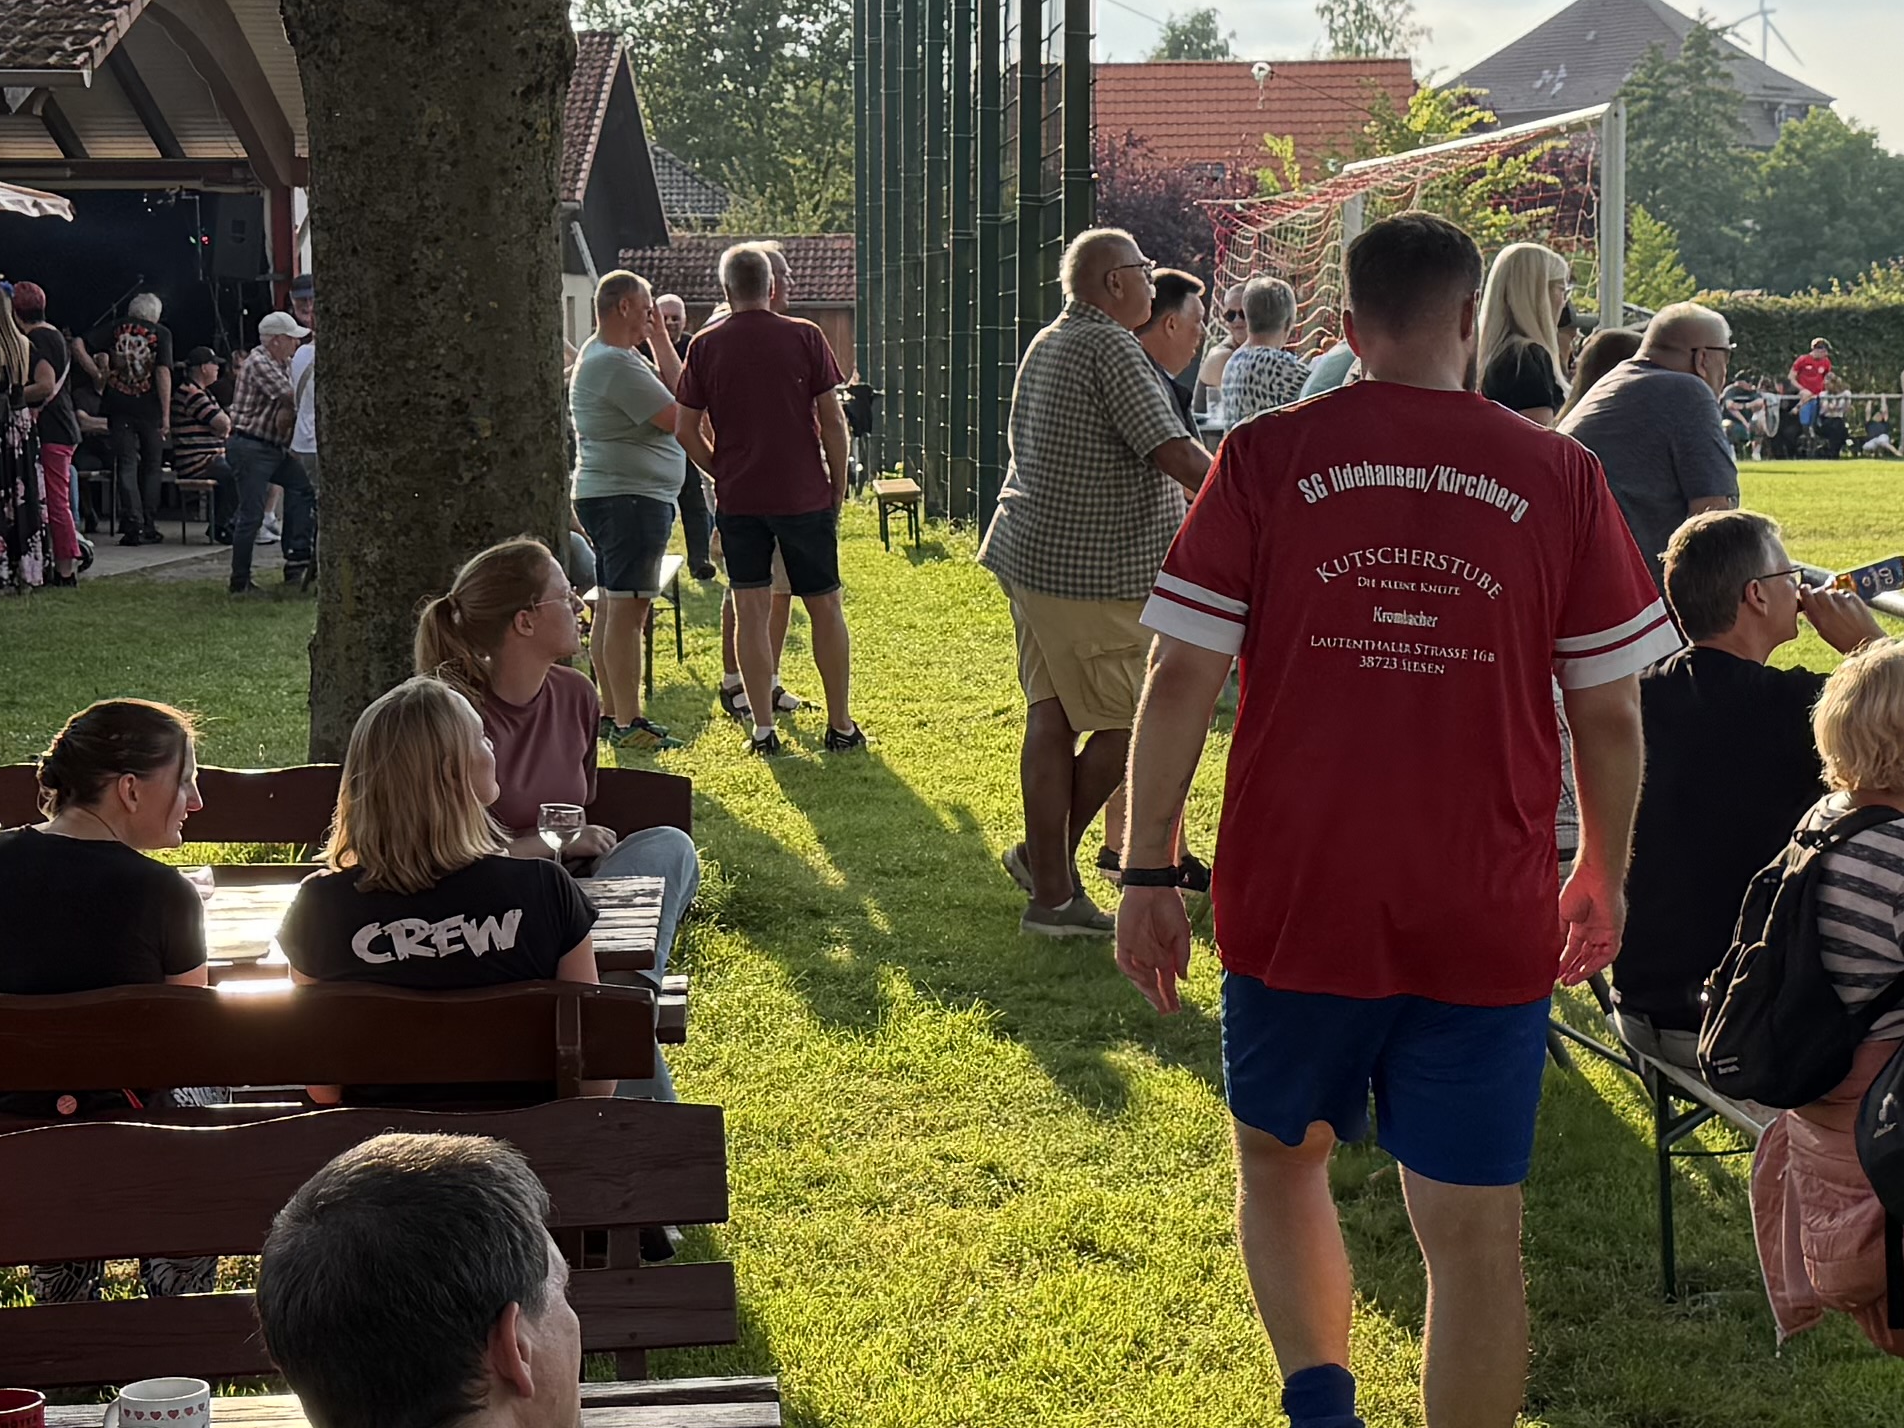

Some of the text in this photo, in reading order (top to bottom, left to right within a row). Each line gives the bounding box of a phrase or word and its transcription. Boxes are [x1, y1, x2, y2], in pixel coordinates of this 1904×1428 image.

[1297, 460, 1529, 523] SG Ildehausen/Kirchberg
[1315, 547, 1503, 600] KUTSCHERSTUBE
[1373, 606, 1438, 628] Krombacher
[1359, 655, 1398, 670] 38723
[1415, 643, 1468, 660] STRASSE
[351, 908, 523, 964] CREW
